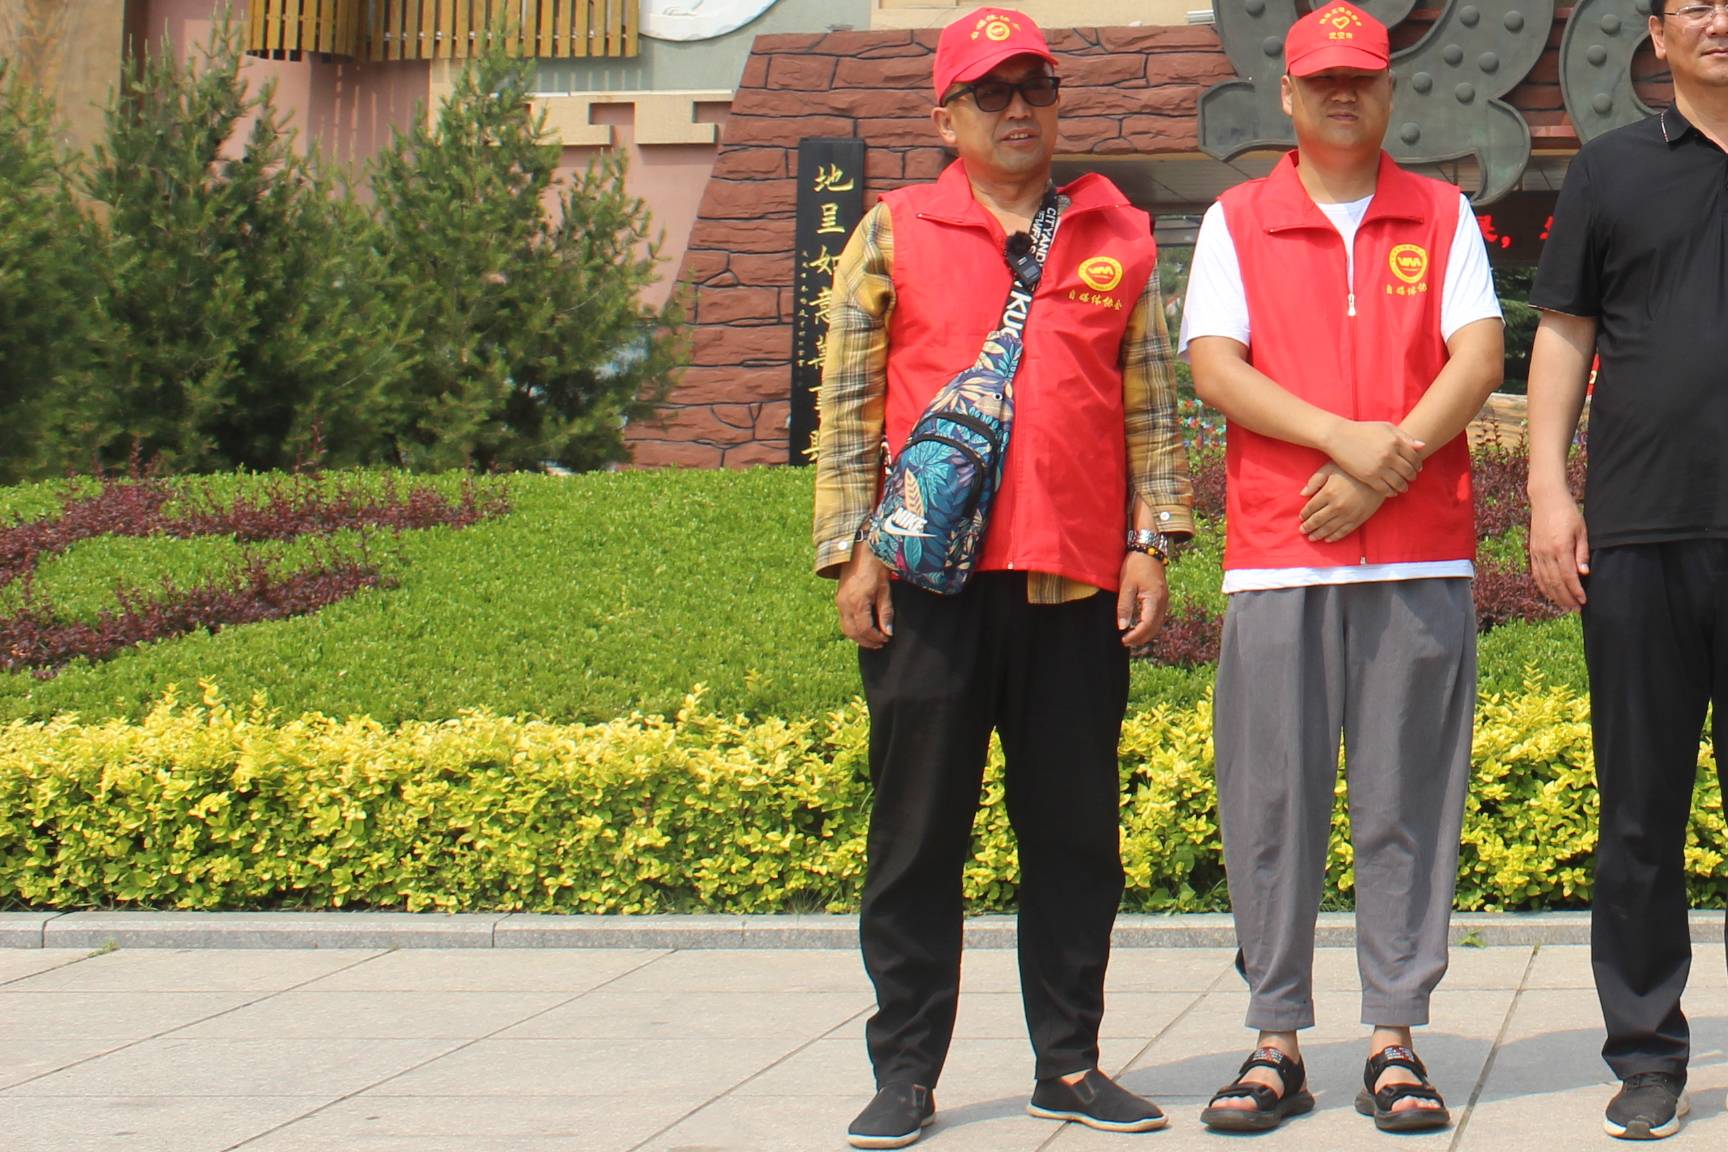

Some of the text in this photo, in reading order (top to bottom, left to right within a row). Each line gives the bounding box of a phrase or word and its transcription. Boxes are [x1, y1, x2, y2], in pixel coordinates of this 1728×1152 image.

[1034, 207, 1057, 267] CITYAND
[801, 162, 855, 465] 地呈如意
[891, 507, 928, 533] NIKE
